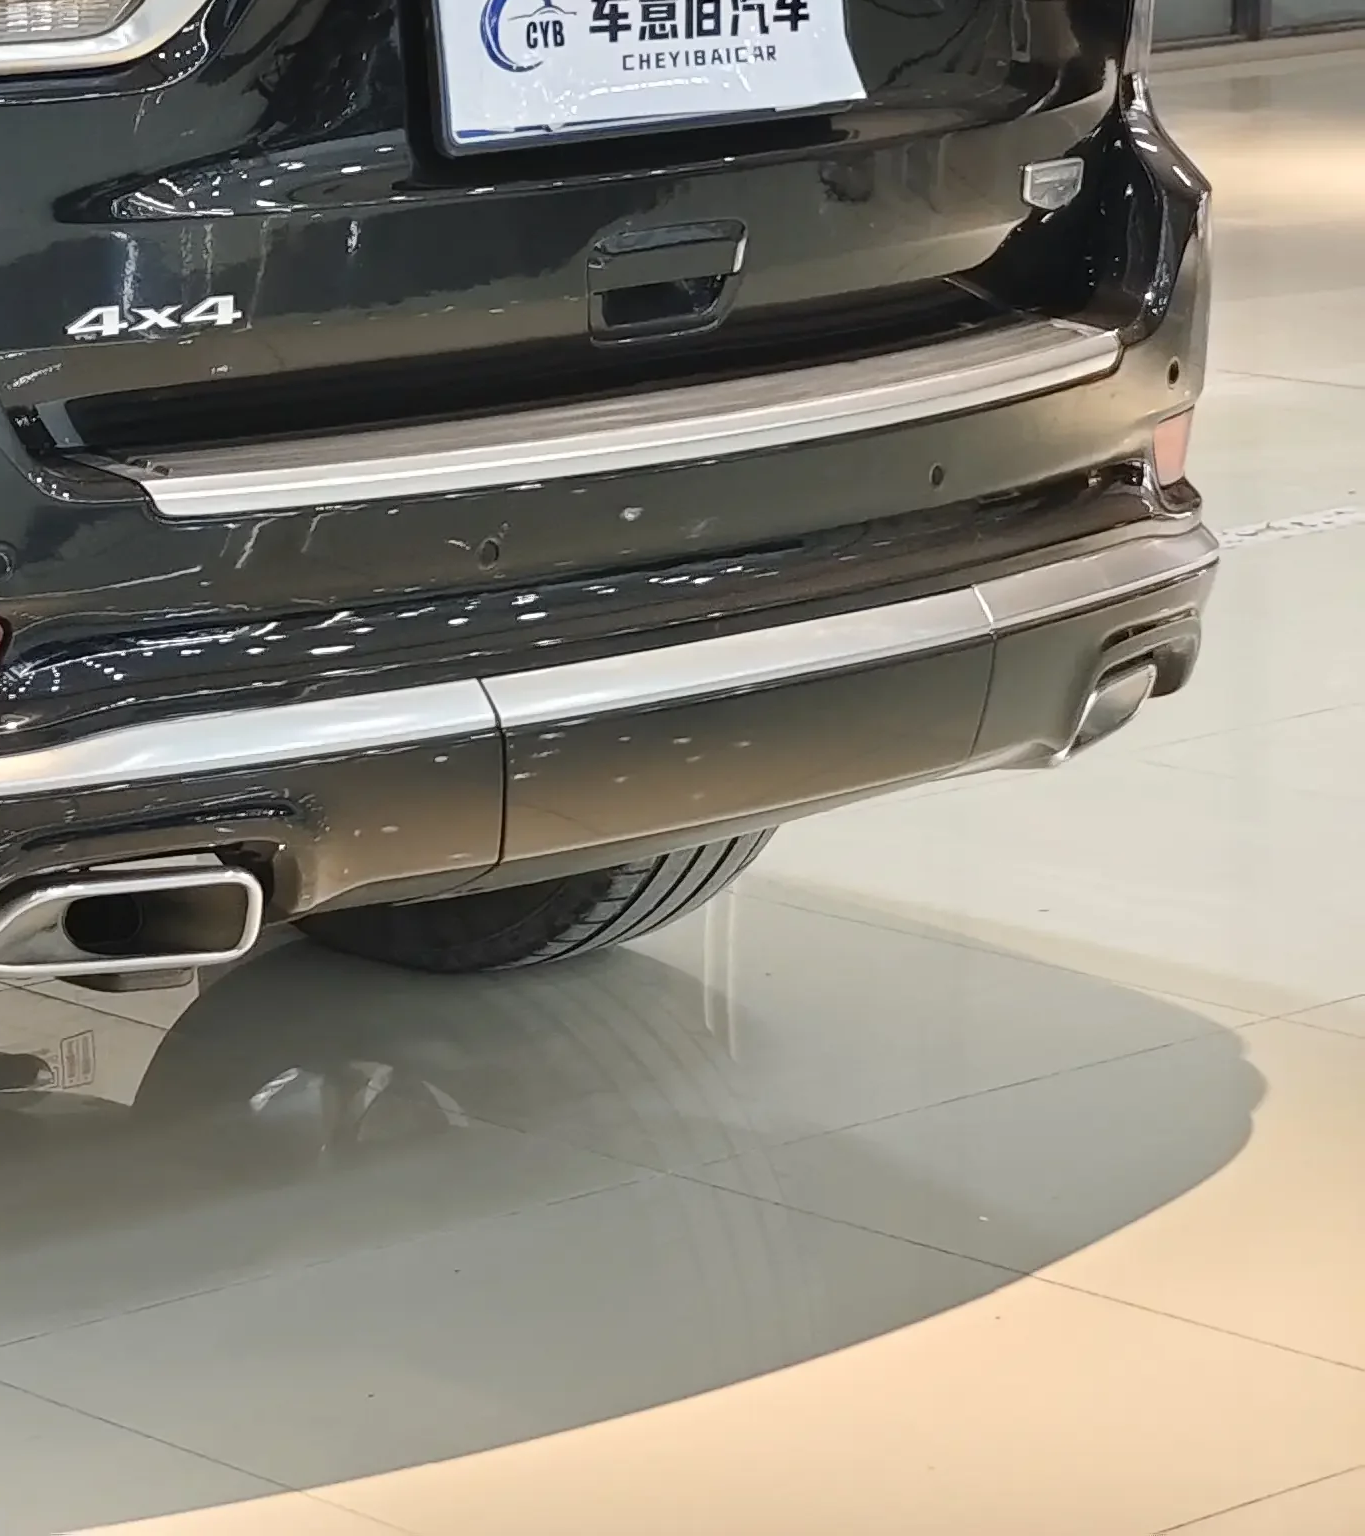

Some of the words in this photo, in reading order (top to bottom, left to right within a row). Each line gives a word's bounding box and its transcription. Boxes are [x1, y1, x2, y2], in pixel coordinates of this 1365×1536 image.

[526, 20, 565, 49] CYB
[622, 45, 777, 71] CHEYIBAICAR
[65, 294, 243, 336] 4x4
